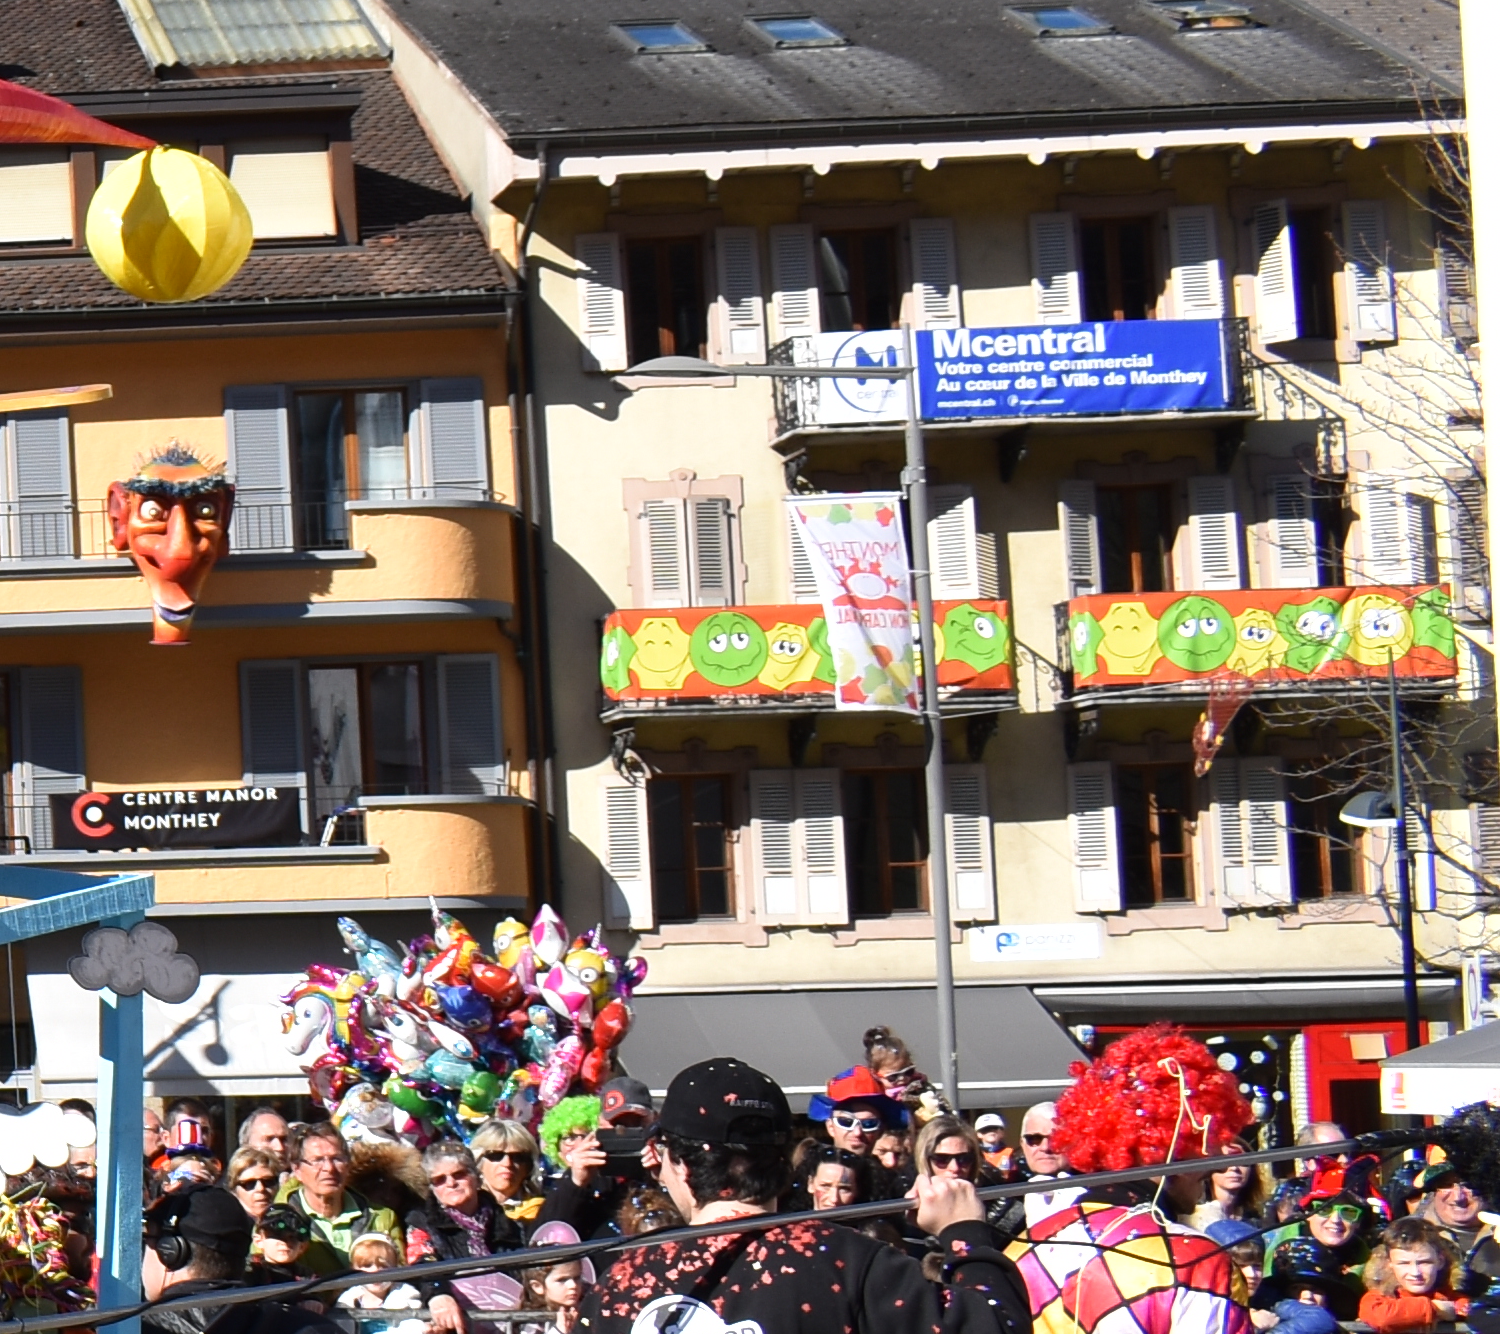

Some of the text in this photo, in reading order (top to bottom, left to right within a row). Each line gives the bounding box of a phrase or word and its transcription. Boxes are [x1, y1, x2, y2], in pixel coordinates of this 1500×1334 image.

[932, 323, 1106, 359] Mcentral
[935, 353, 1154, 376] Votre centre commercial
[936, 377, 962, 392] Au
[1014, 375, 1038, 390] de
[1041, 374, 1058, 389] la
[1061, 372, 1100, 387] Ville
[1103, 371, 1127, 386] de
[1130, 369, 1208, 386] Monthey
[122, 787, 279, 806] CENTRE MANOR
[123, 812, 222, 830] MONTHEY
